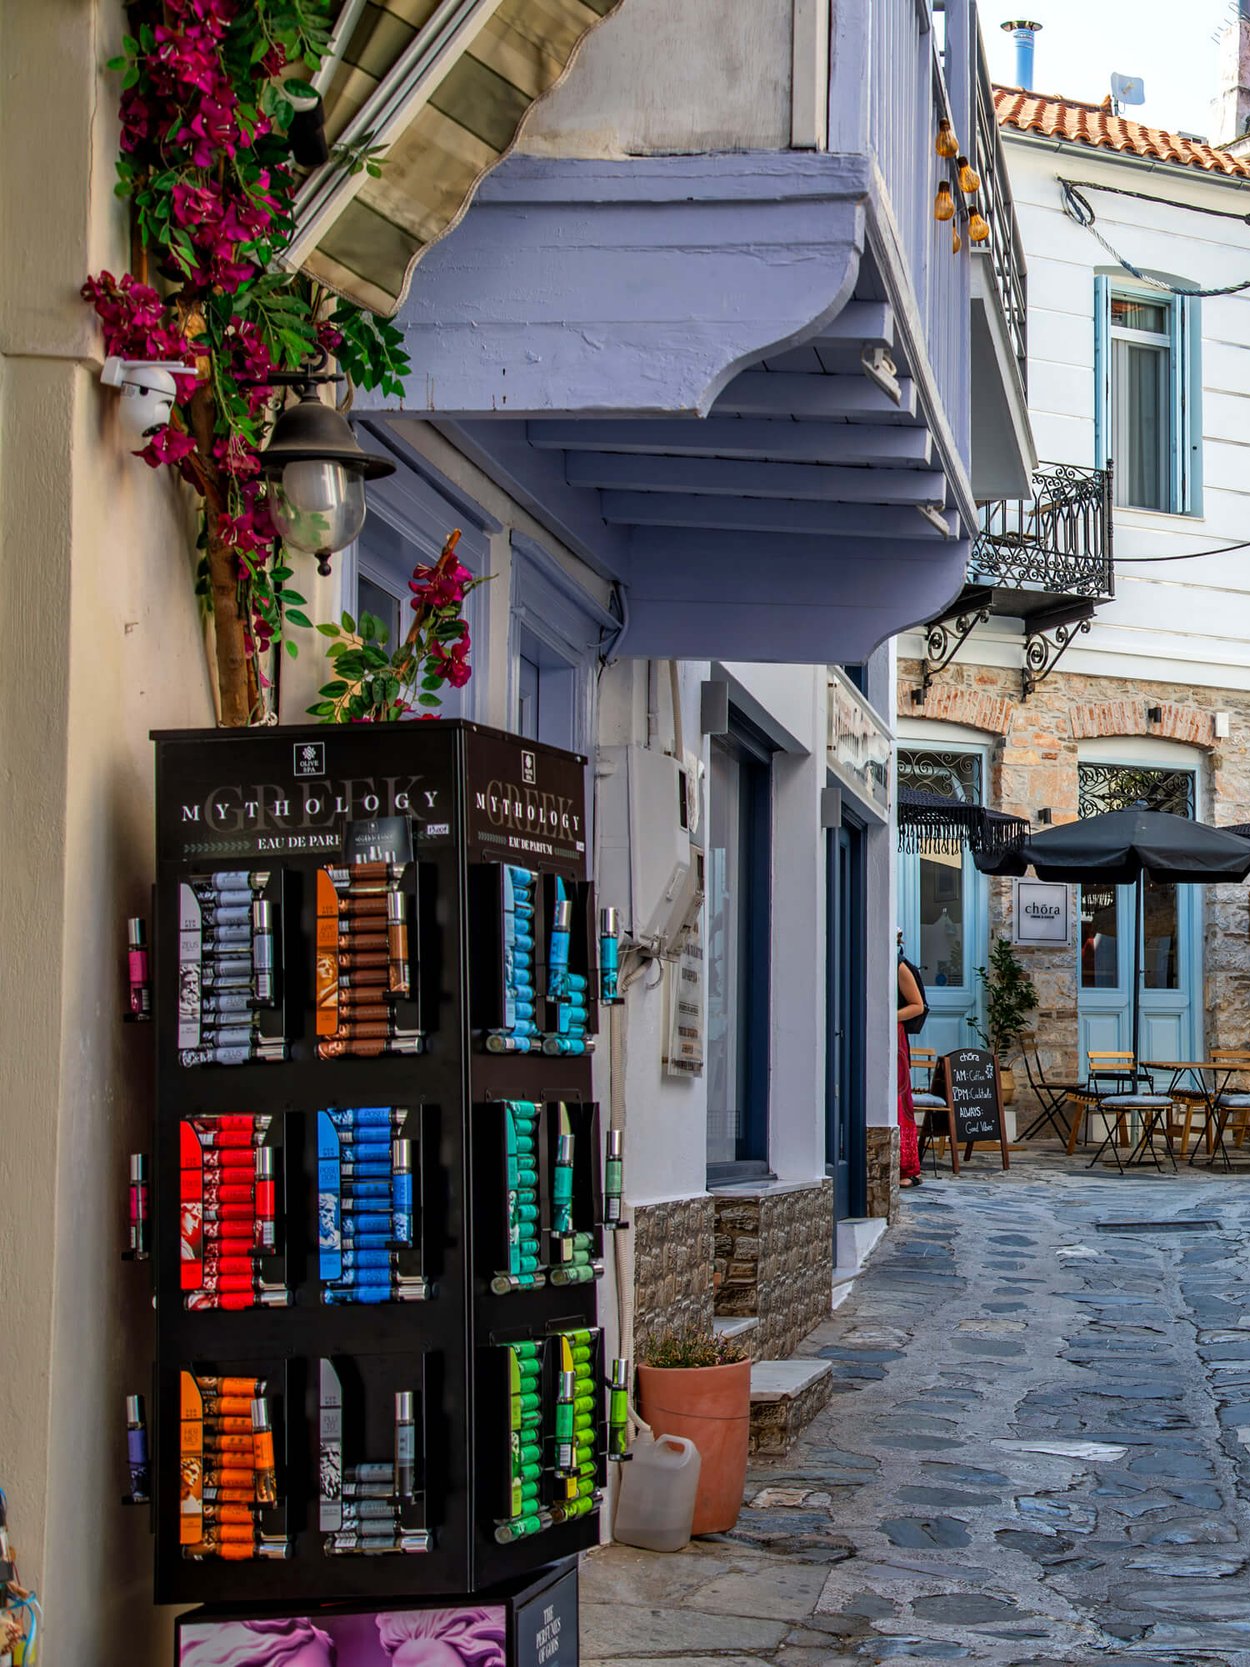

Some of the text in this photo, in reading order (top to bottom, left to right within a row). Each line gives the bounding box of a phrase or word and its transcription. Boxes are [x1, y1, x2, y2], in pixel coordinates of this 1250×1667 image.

[182, 791, 438, 821] MYTHOLOGY
[204, 775, 425, 833] GREEK
[476, 792, 579, 831] MYTHOLOGY
[486, 779, 575, 841] GREEK
[258, 837, 284, 850] EAU
[288, 836, 306, 848] DE
[508, 836, 553, 855] EAU DE PARFUM
[543, 1604, 554, 1626] THE
[536, 1616, 561, 1650] PERFUMES
